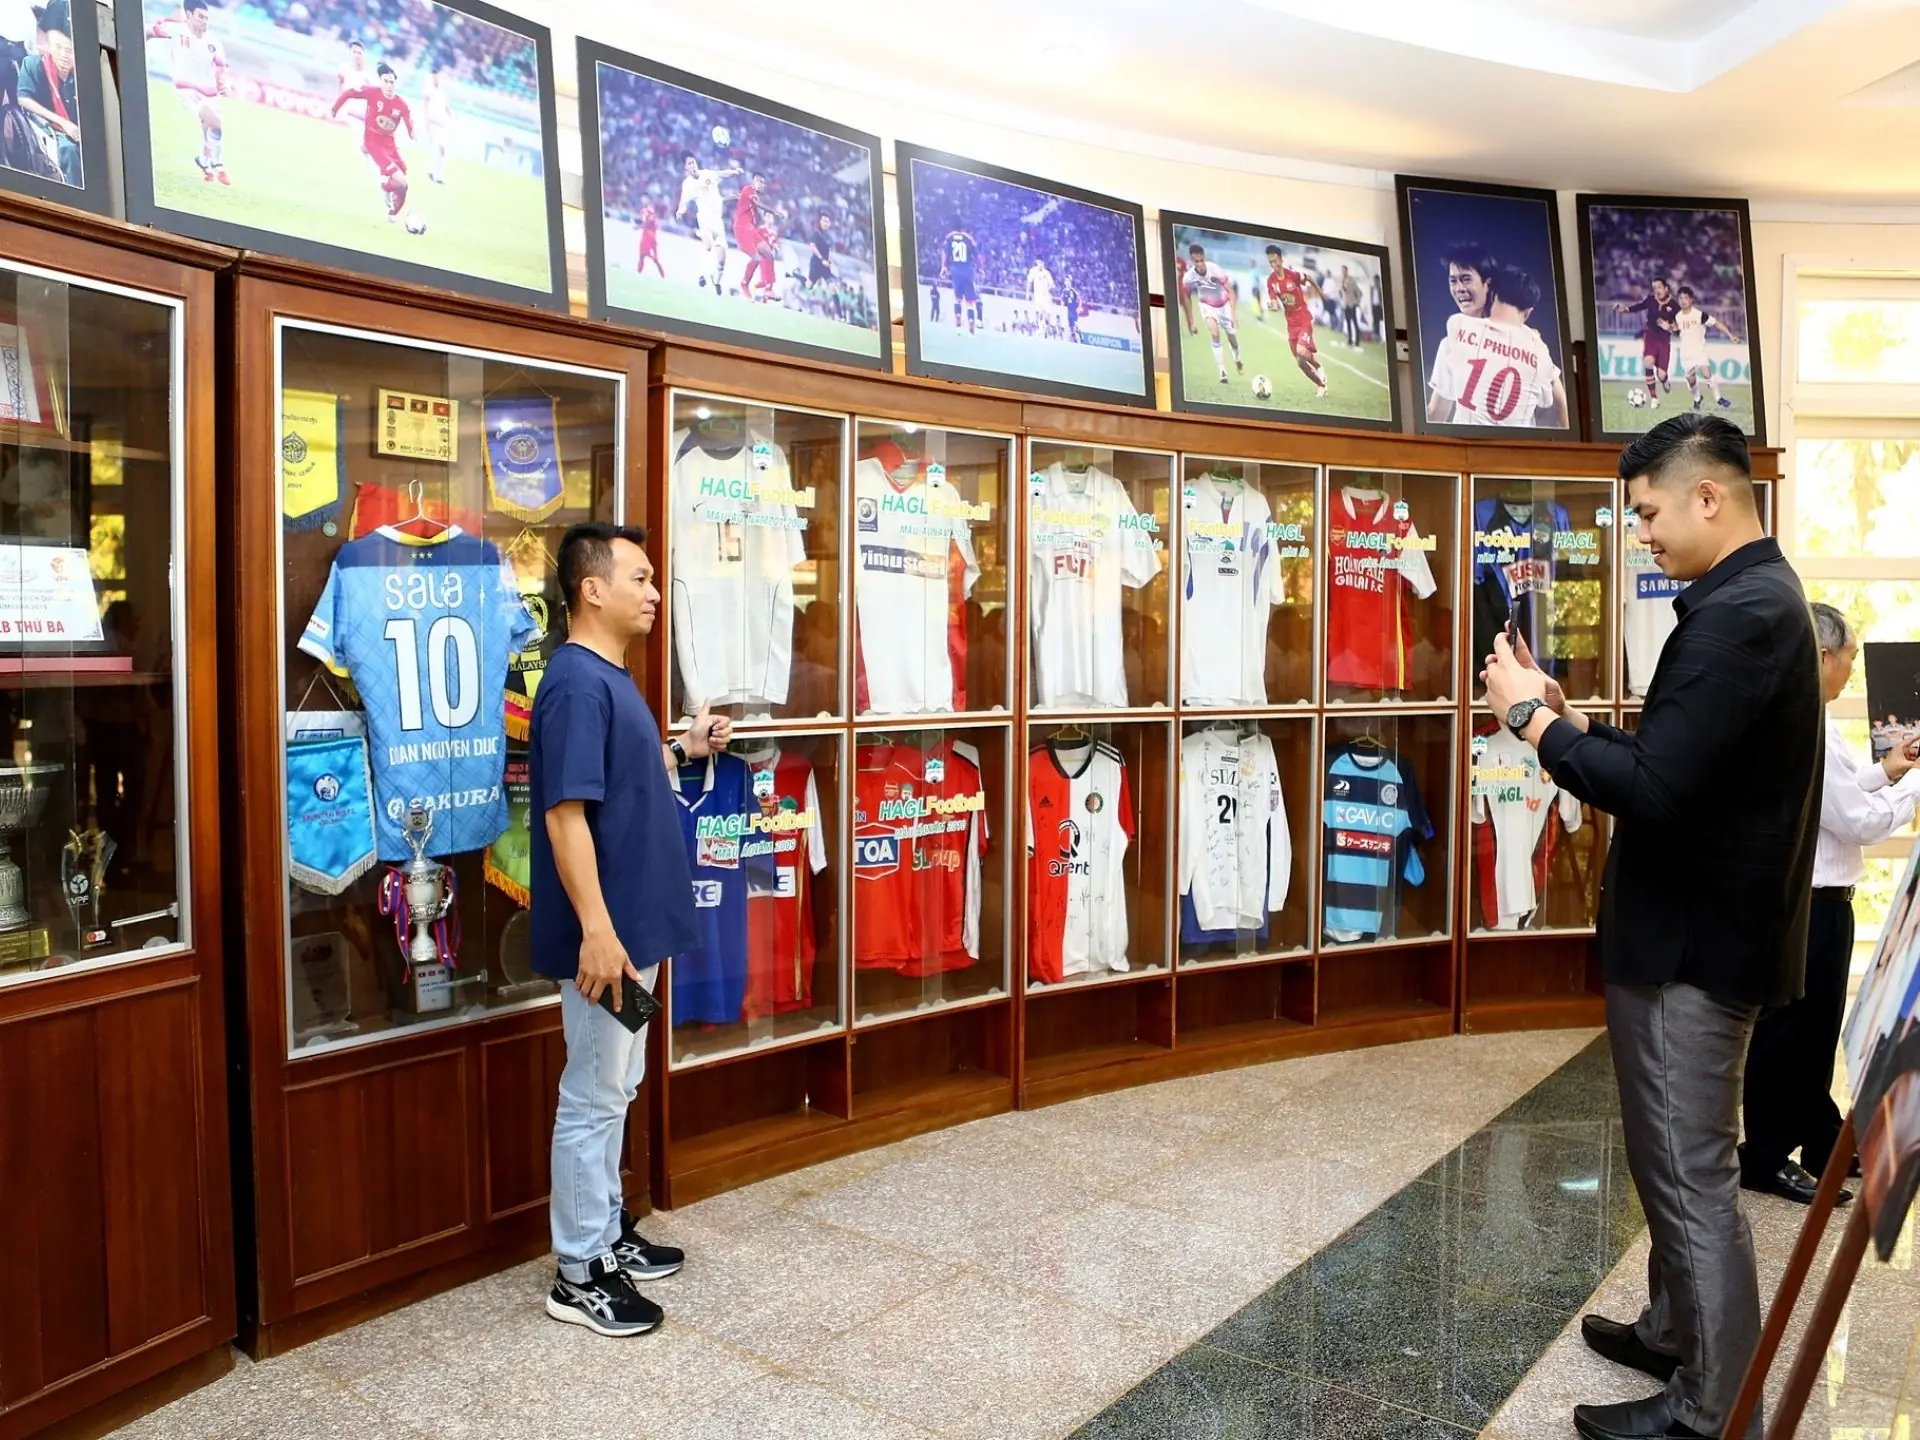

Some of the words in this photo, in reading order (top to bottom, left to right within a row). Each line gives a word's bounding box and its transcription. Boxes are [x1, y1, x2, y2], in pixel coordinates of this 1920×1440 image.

[952, 241, 967, 262] 20
[1457, 329, 1478, 346] N.C.
[1483, 338, 1538, 369] PHUONG
[1457, 358, 1521, 422] 10
[699, 477, 753, 500] HAGL
[882, 494, 928, 515] HAGL
[1118, 513, 1159, 532] HAGL
[1266, 522, 1306, 541] HAGL
[1346, 531, 1387, 549] HAGL
[1474, 530, 1532, 549] Football
[1553, 531, 1597, 549] HAGL
[46, 621, 65, 633] BA
[383, 615, 481, 732] 10
[473, 737, 499, 757] DUC
[880, 798, 926, 820] HAGL
[925, 792, 985, 815] Football
[697, 814, 753, 839] HAGL
[750, 807, 816, 833] Football
[71, 896, 89, 905] VPF
